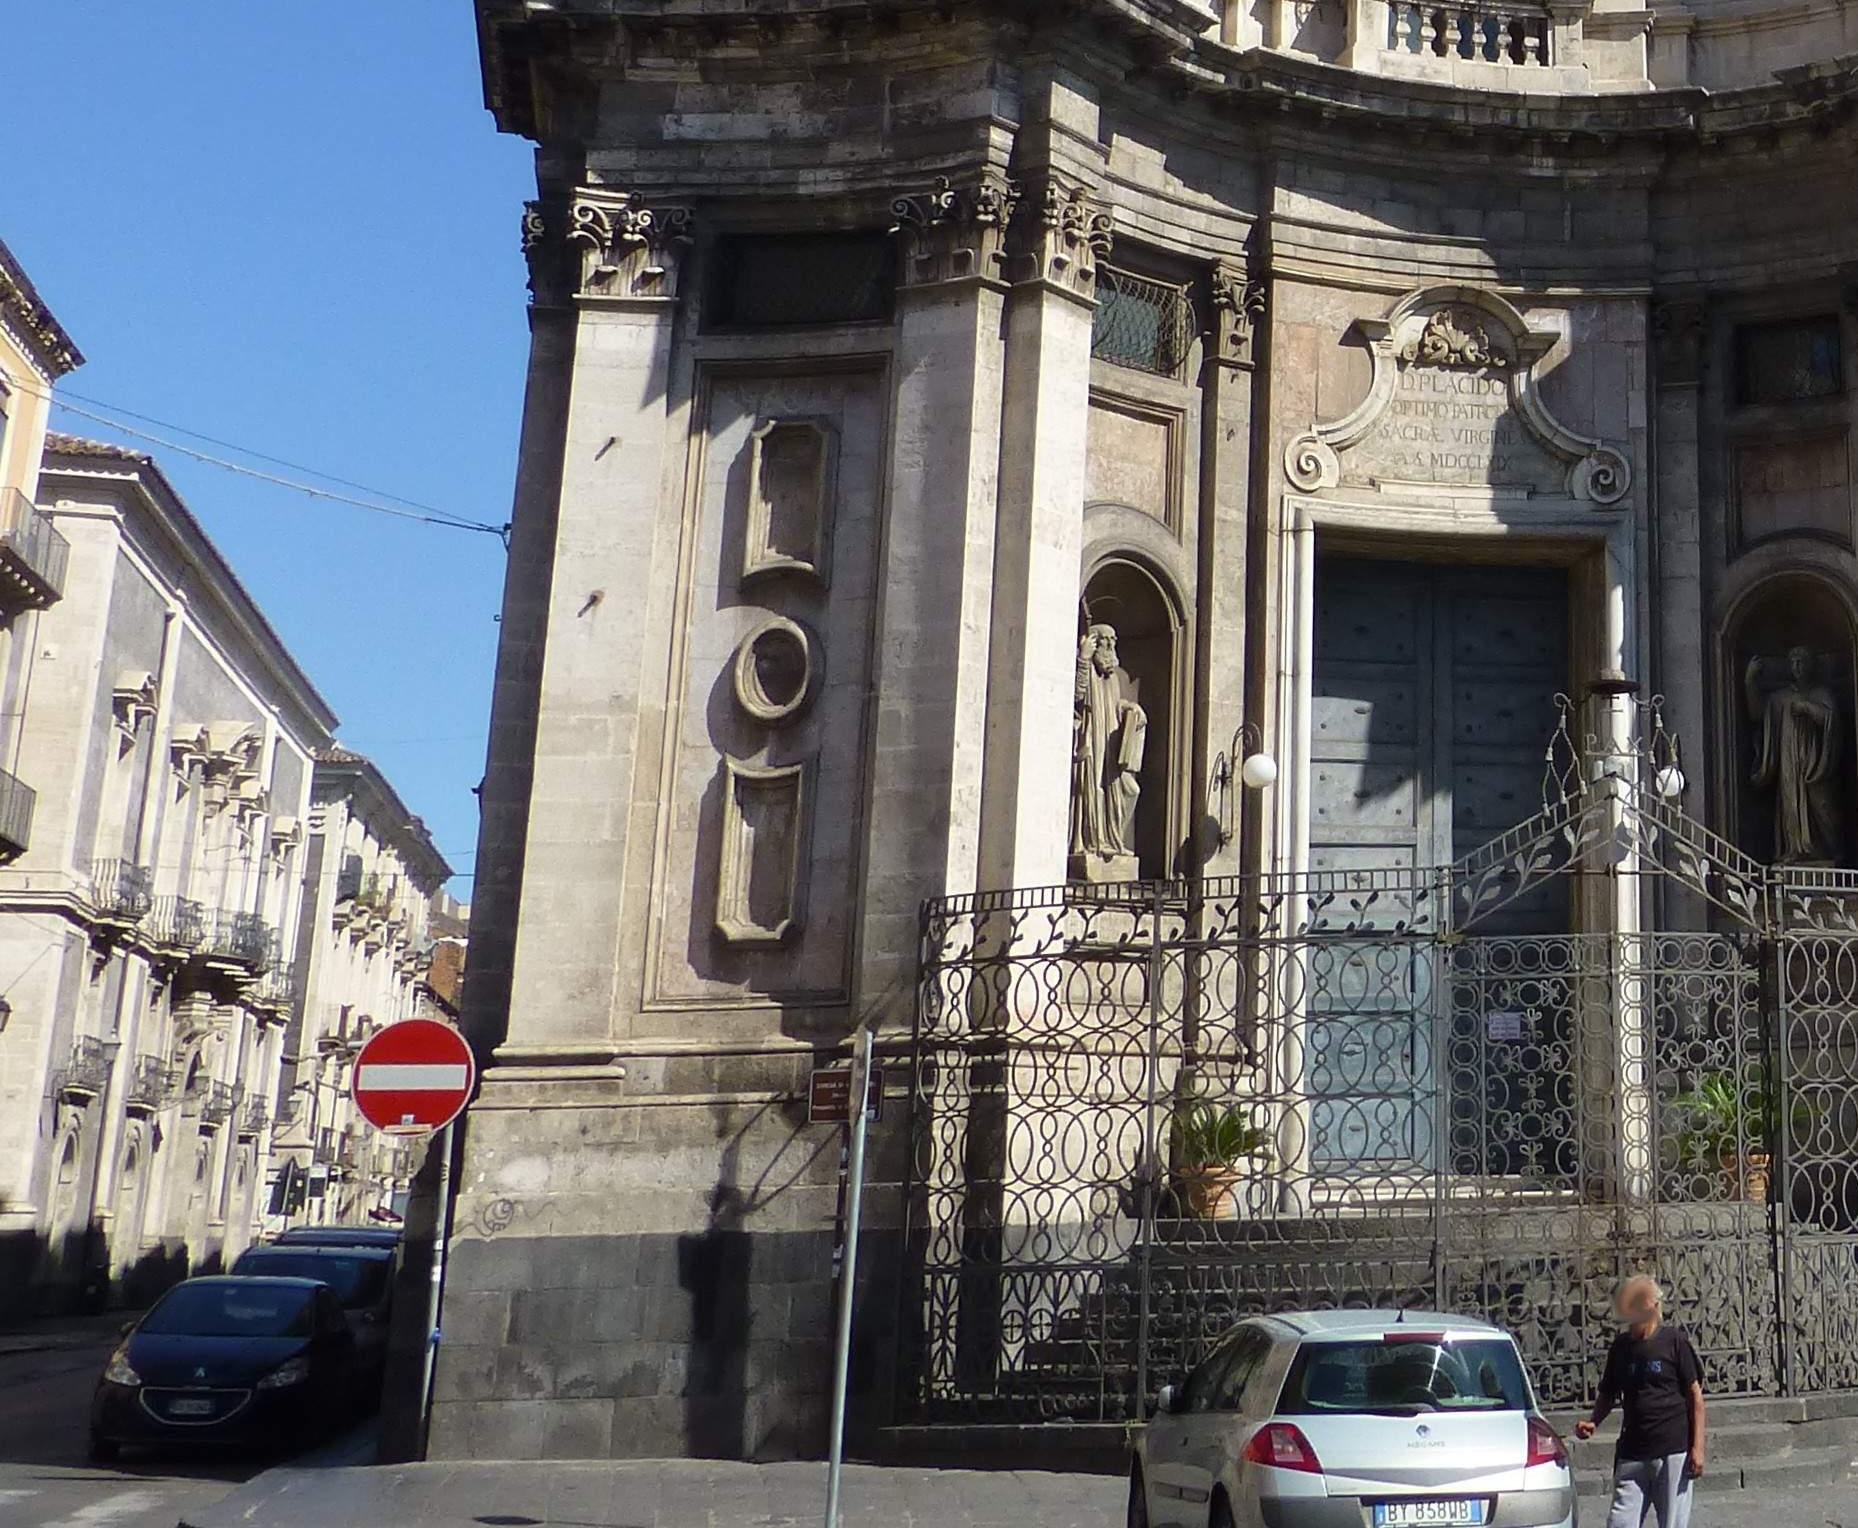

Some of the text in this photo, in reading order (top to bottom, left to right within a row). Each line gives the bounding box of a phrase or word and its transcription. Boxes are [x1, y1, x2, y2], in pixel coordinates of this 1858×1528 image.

[1391, 400, 1449, 418] OPTIMO
[1388, 1500, 1468, 1522] BY 858WB
